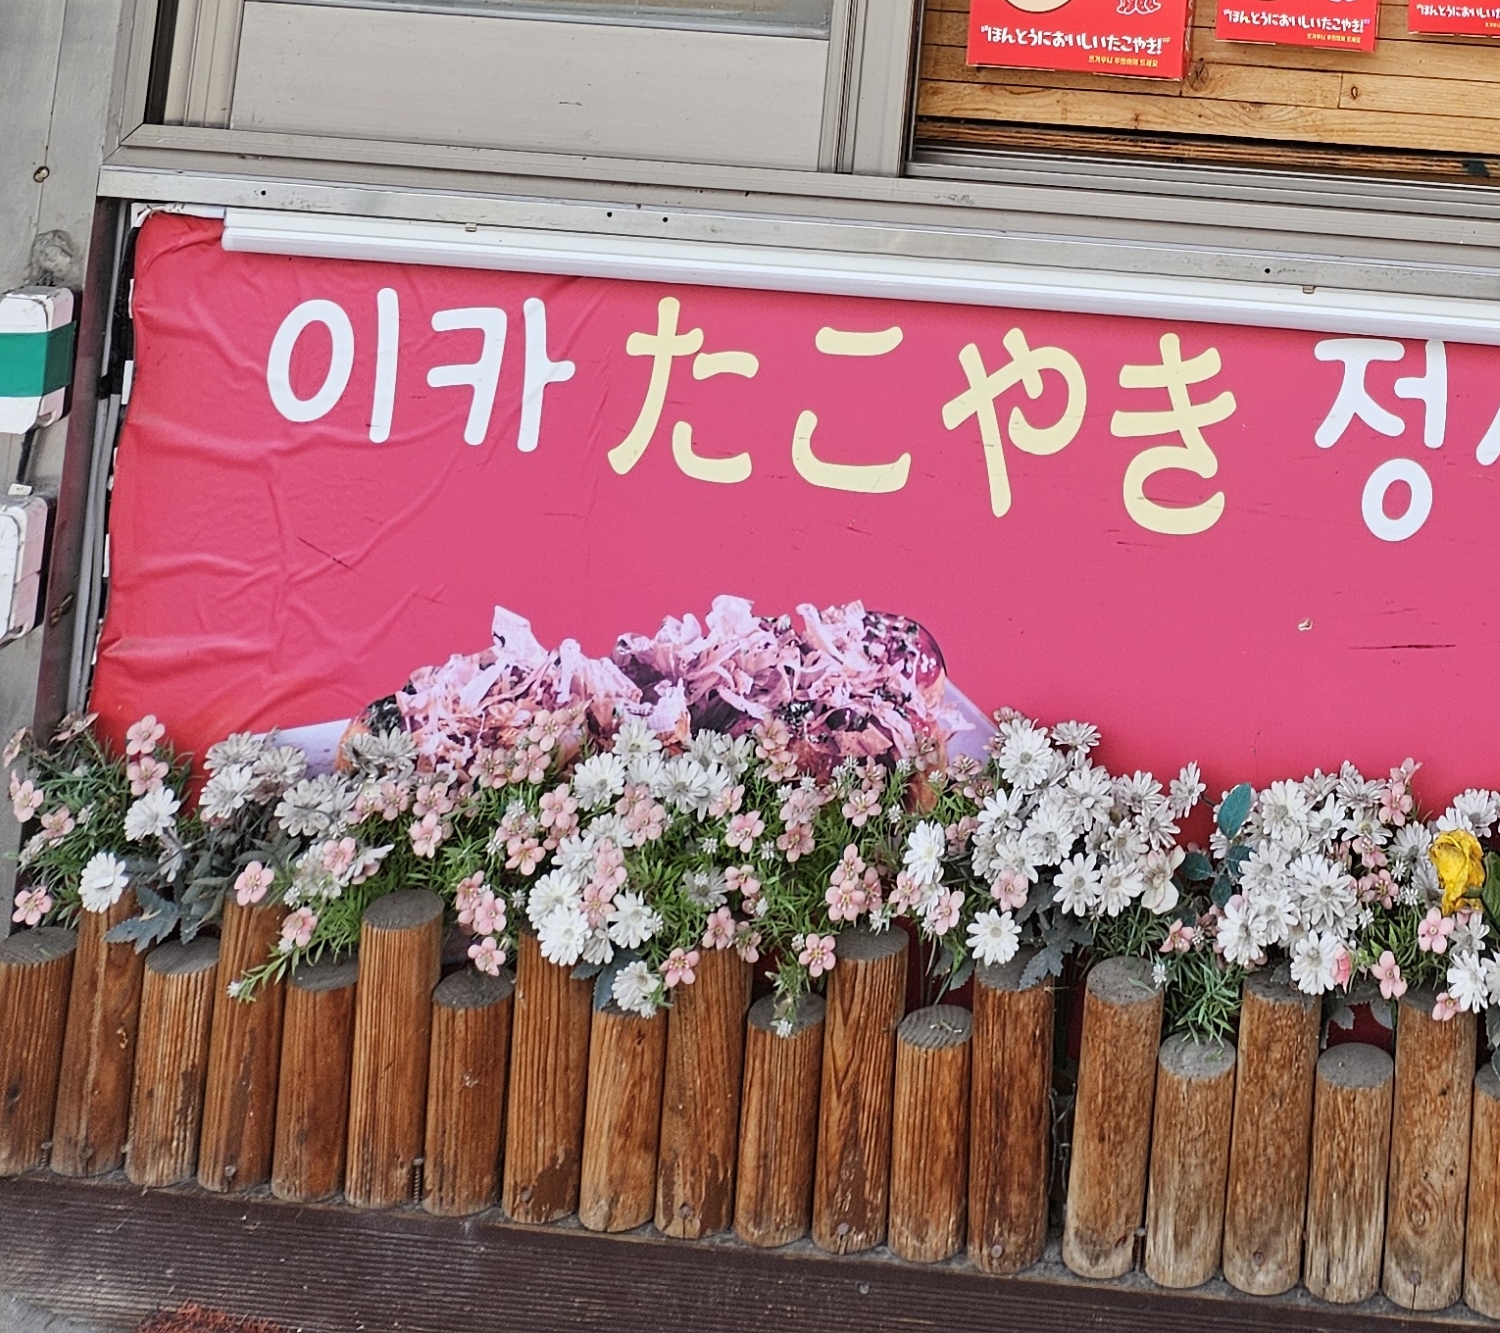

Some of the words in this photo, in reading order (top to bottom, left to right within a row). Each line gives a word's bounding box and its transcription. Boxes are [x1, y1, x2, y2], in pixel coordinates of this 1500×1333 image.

[266, 288, 577, 453] 이카
[607, 296, 1237, 536] たこやき
